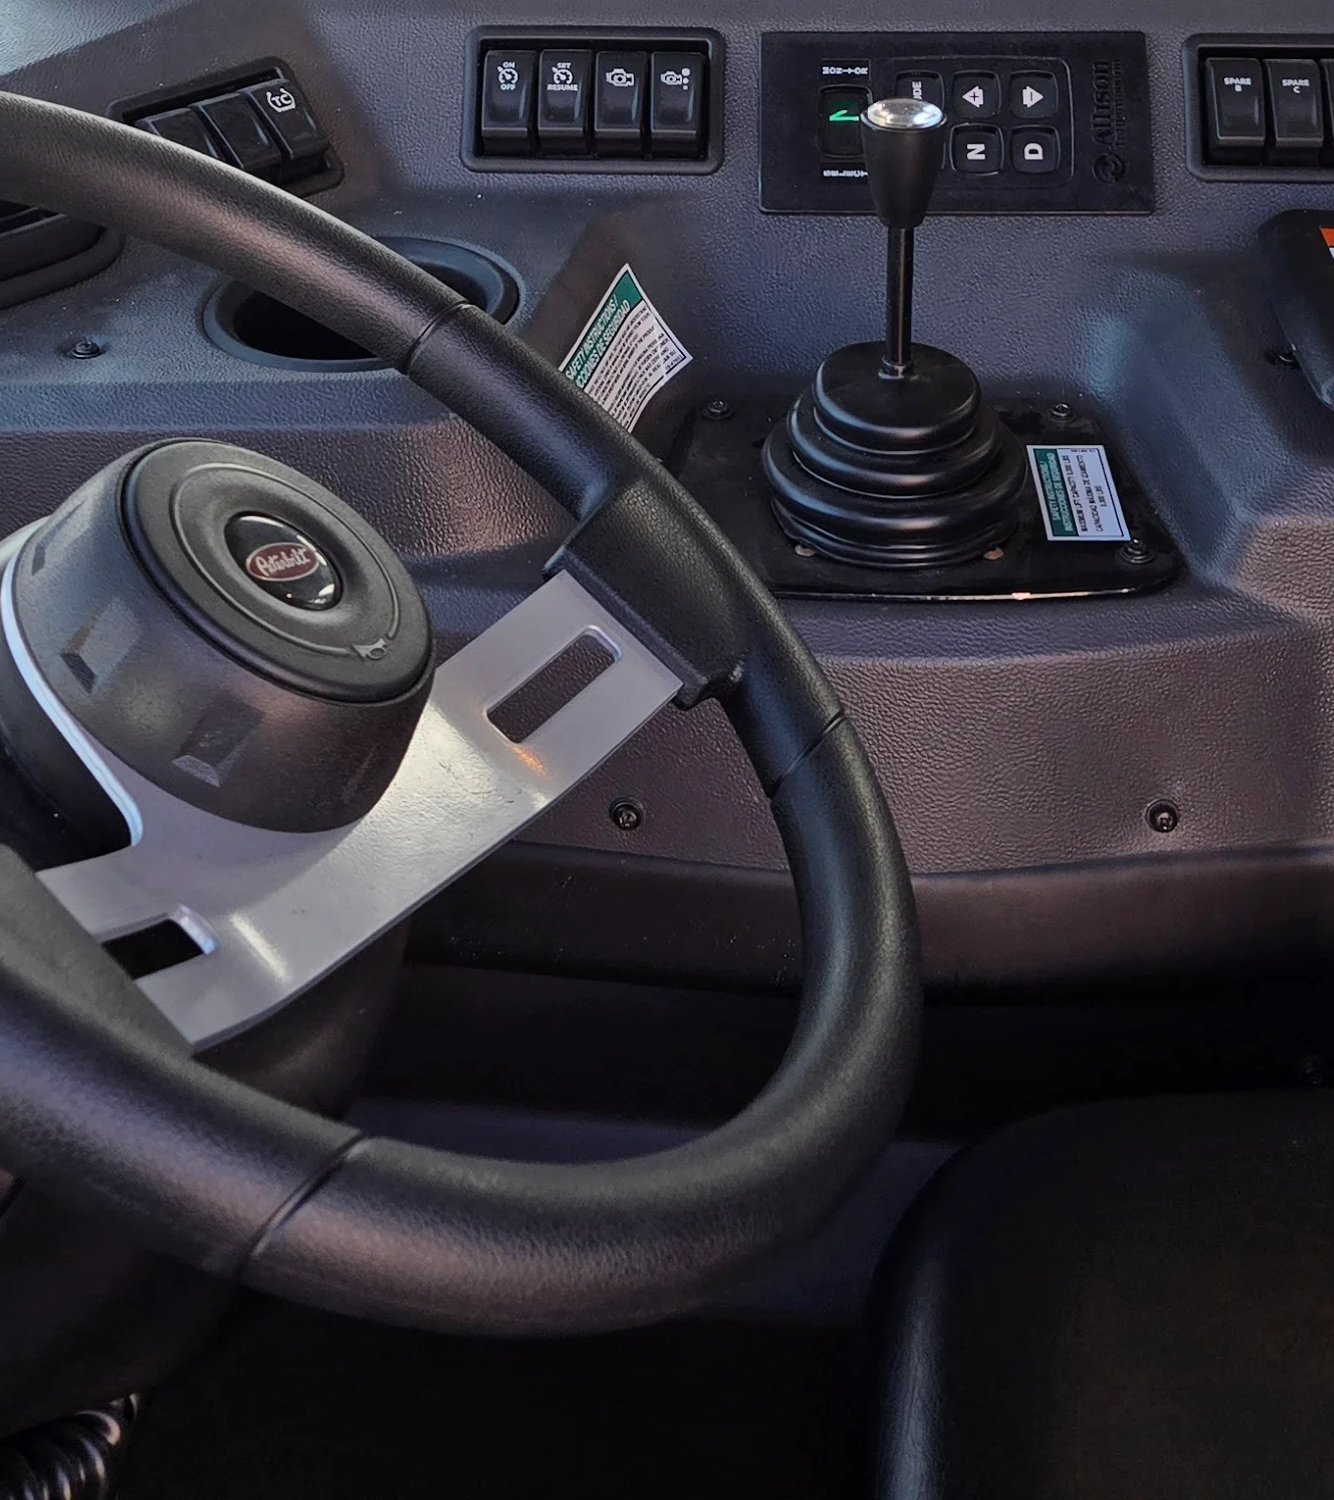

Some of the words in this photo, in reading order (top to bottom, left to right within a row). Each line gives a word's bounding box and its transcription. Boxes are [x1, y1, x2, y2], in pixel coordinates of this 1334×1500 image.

[822, 66, 868, 75] MONITOR
[1224, 77, 1252, 85] SPARE
[1282, 78, 1310, 87] SPARE
[500, 83, 515, 91] OFF
[547, 83, 578, 91] RESUME
[1235, 84, 1242, 92] B
[1293, 86, 1300, 94] C
[272, 93, 293, 108] TC
[1091, 59, 1112, 149] Allison
[967, 143, 986, 160] N
[1024, 143, 1044, 160] D
[823, 169, 869, 178] SELECT
[602, 299, 631, 344] SEGURIDAD
[565, 347, 586, 381] SAFETY
[582, 299, 618, 352] INSTRUCTIONS
[255, 546, 312, 578] Peterbilt
